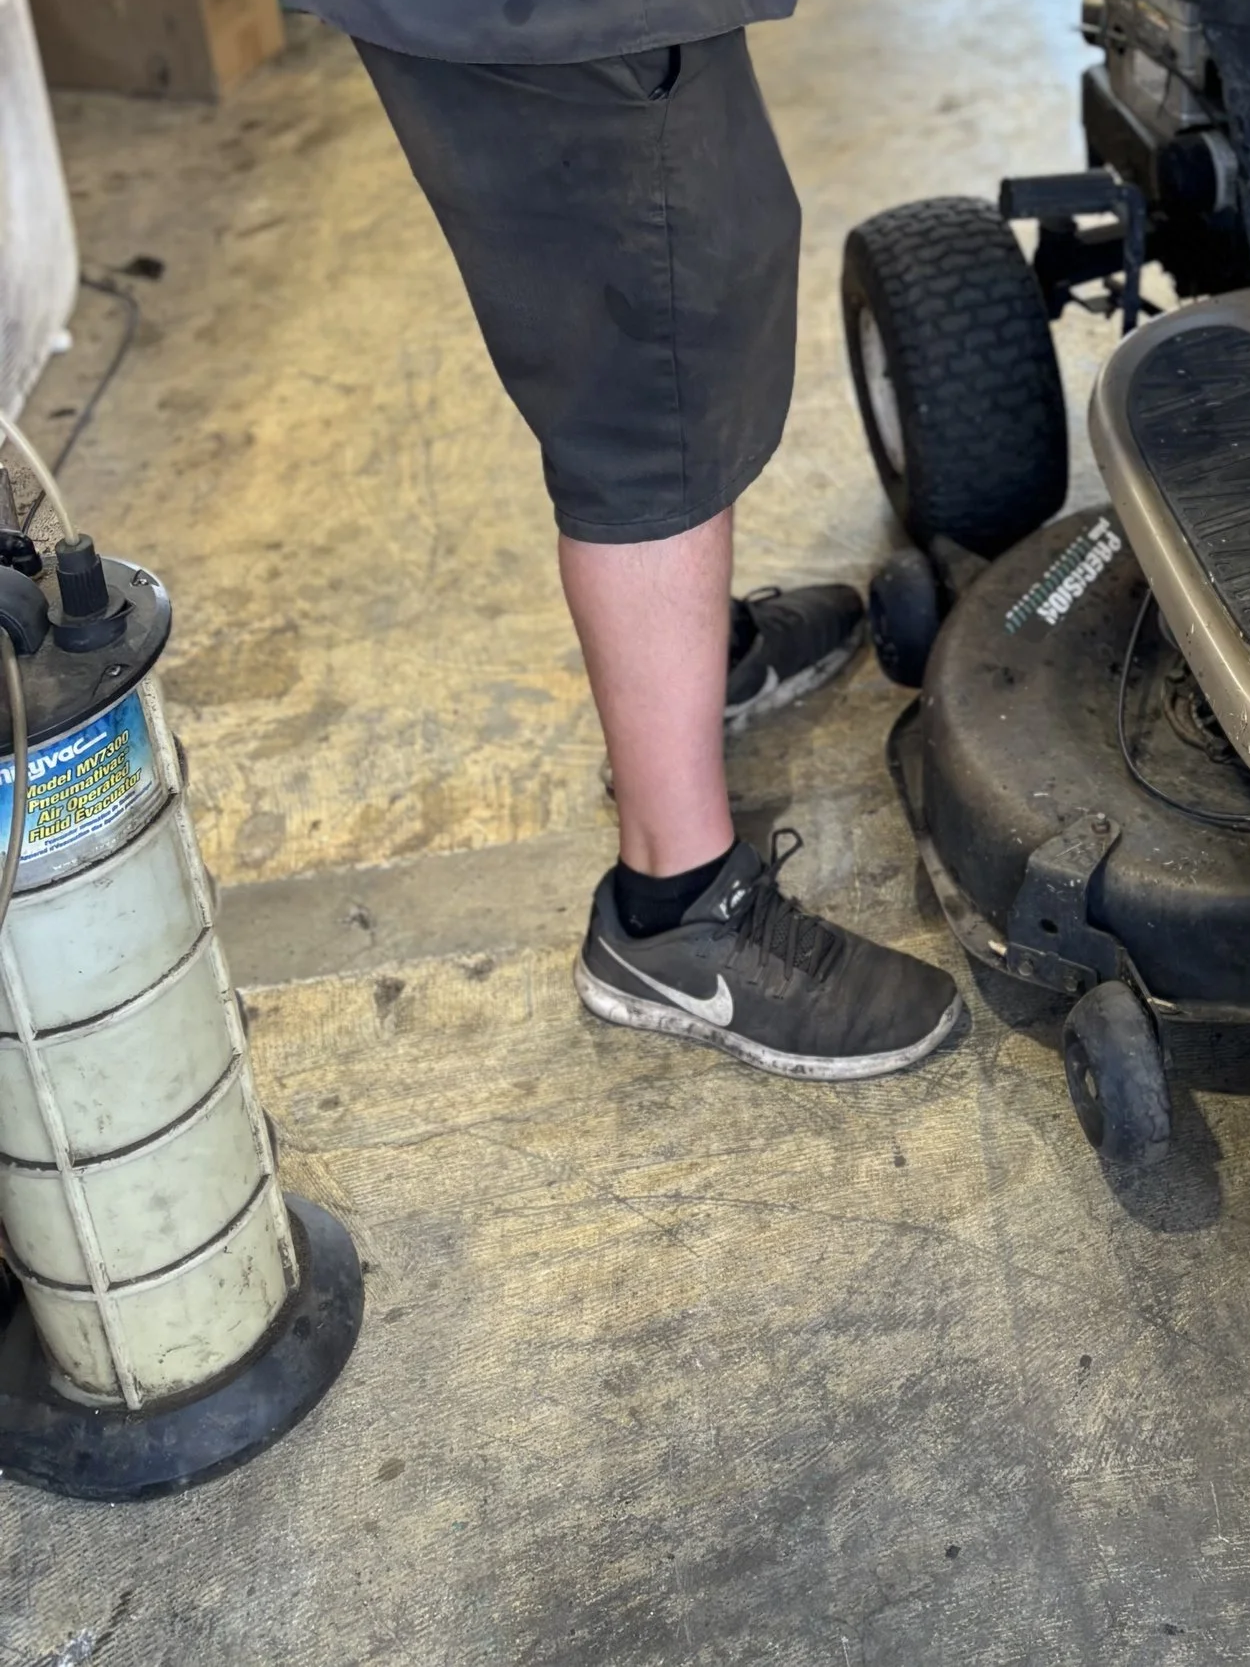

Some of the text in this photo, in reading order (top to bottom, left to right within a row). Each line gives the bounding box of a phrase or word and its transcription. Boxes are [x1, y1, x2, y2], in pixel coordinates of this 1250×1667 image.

[27, 729, 130, 799] Model MV7300
[37, 809, 64, 826] Air
[66, 761, 130, 812] Operated
[28, 819, 71, 843] Fluid
[74, 768, 142, 824] Evacuator
